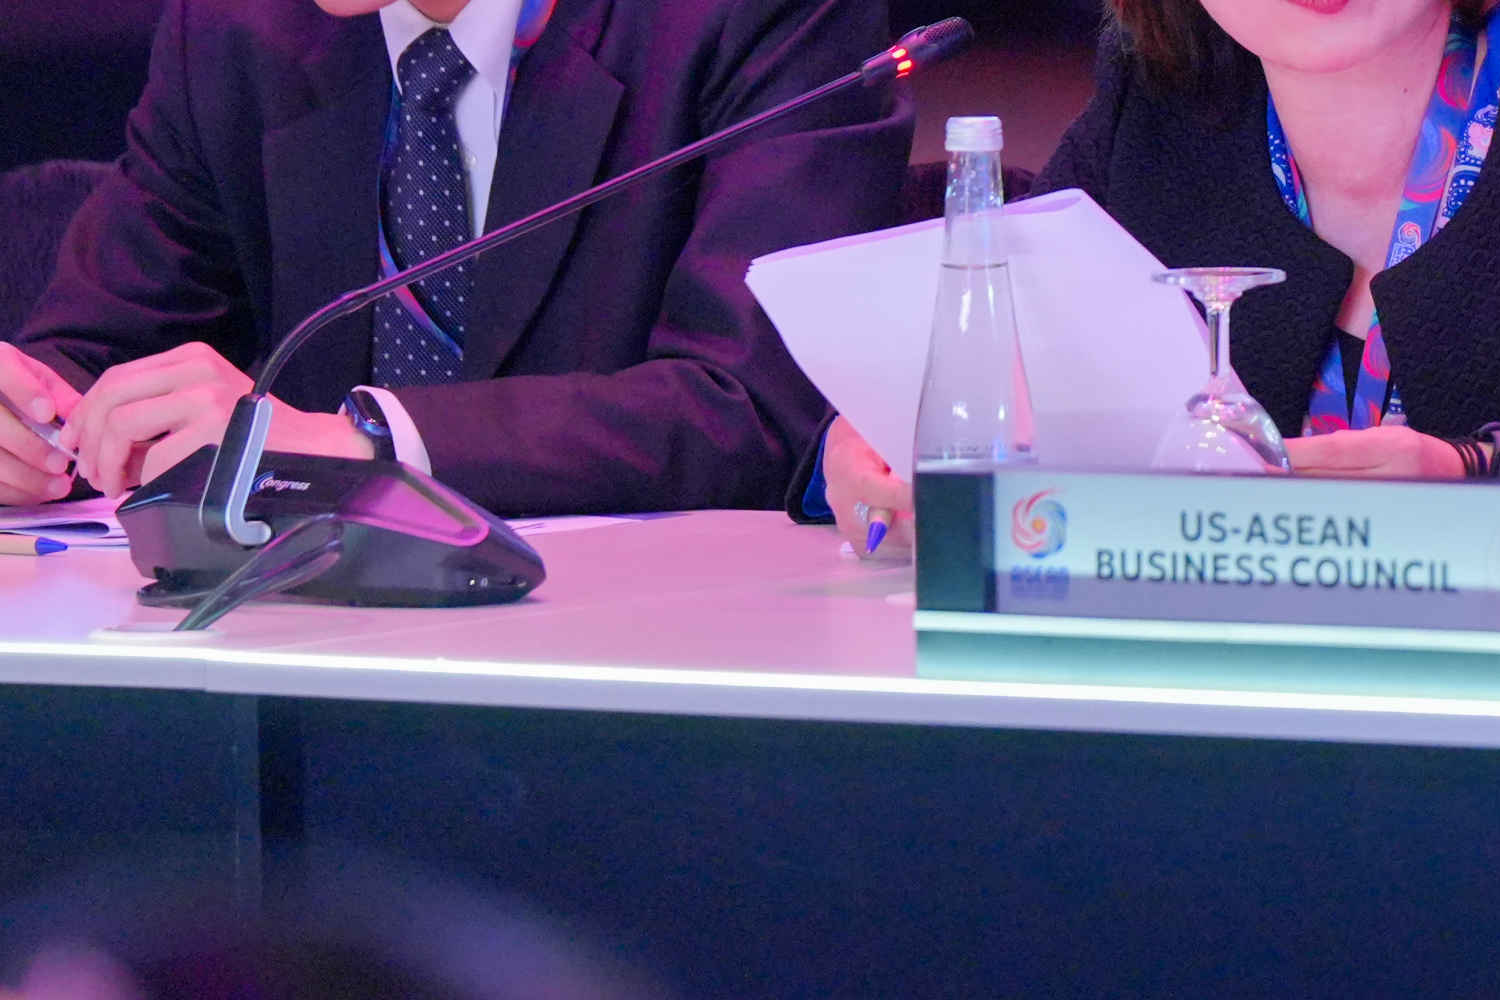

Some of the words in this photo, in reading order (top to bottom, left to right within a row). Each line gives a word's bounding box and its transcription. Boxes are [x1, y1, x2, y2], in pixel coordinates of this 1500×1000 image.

[258, 476, 311, 492] Congress
[1179, 510, 1371, 548] US-ASEAN
[1096, 549, 1279, 586] BUSINESS
[1289, 557, 1459, 593] COUNCIL
